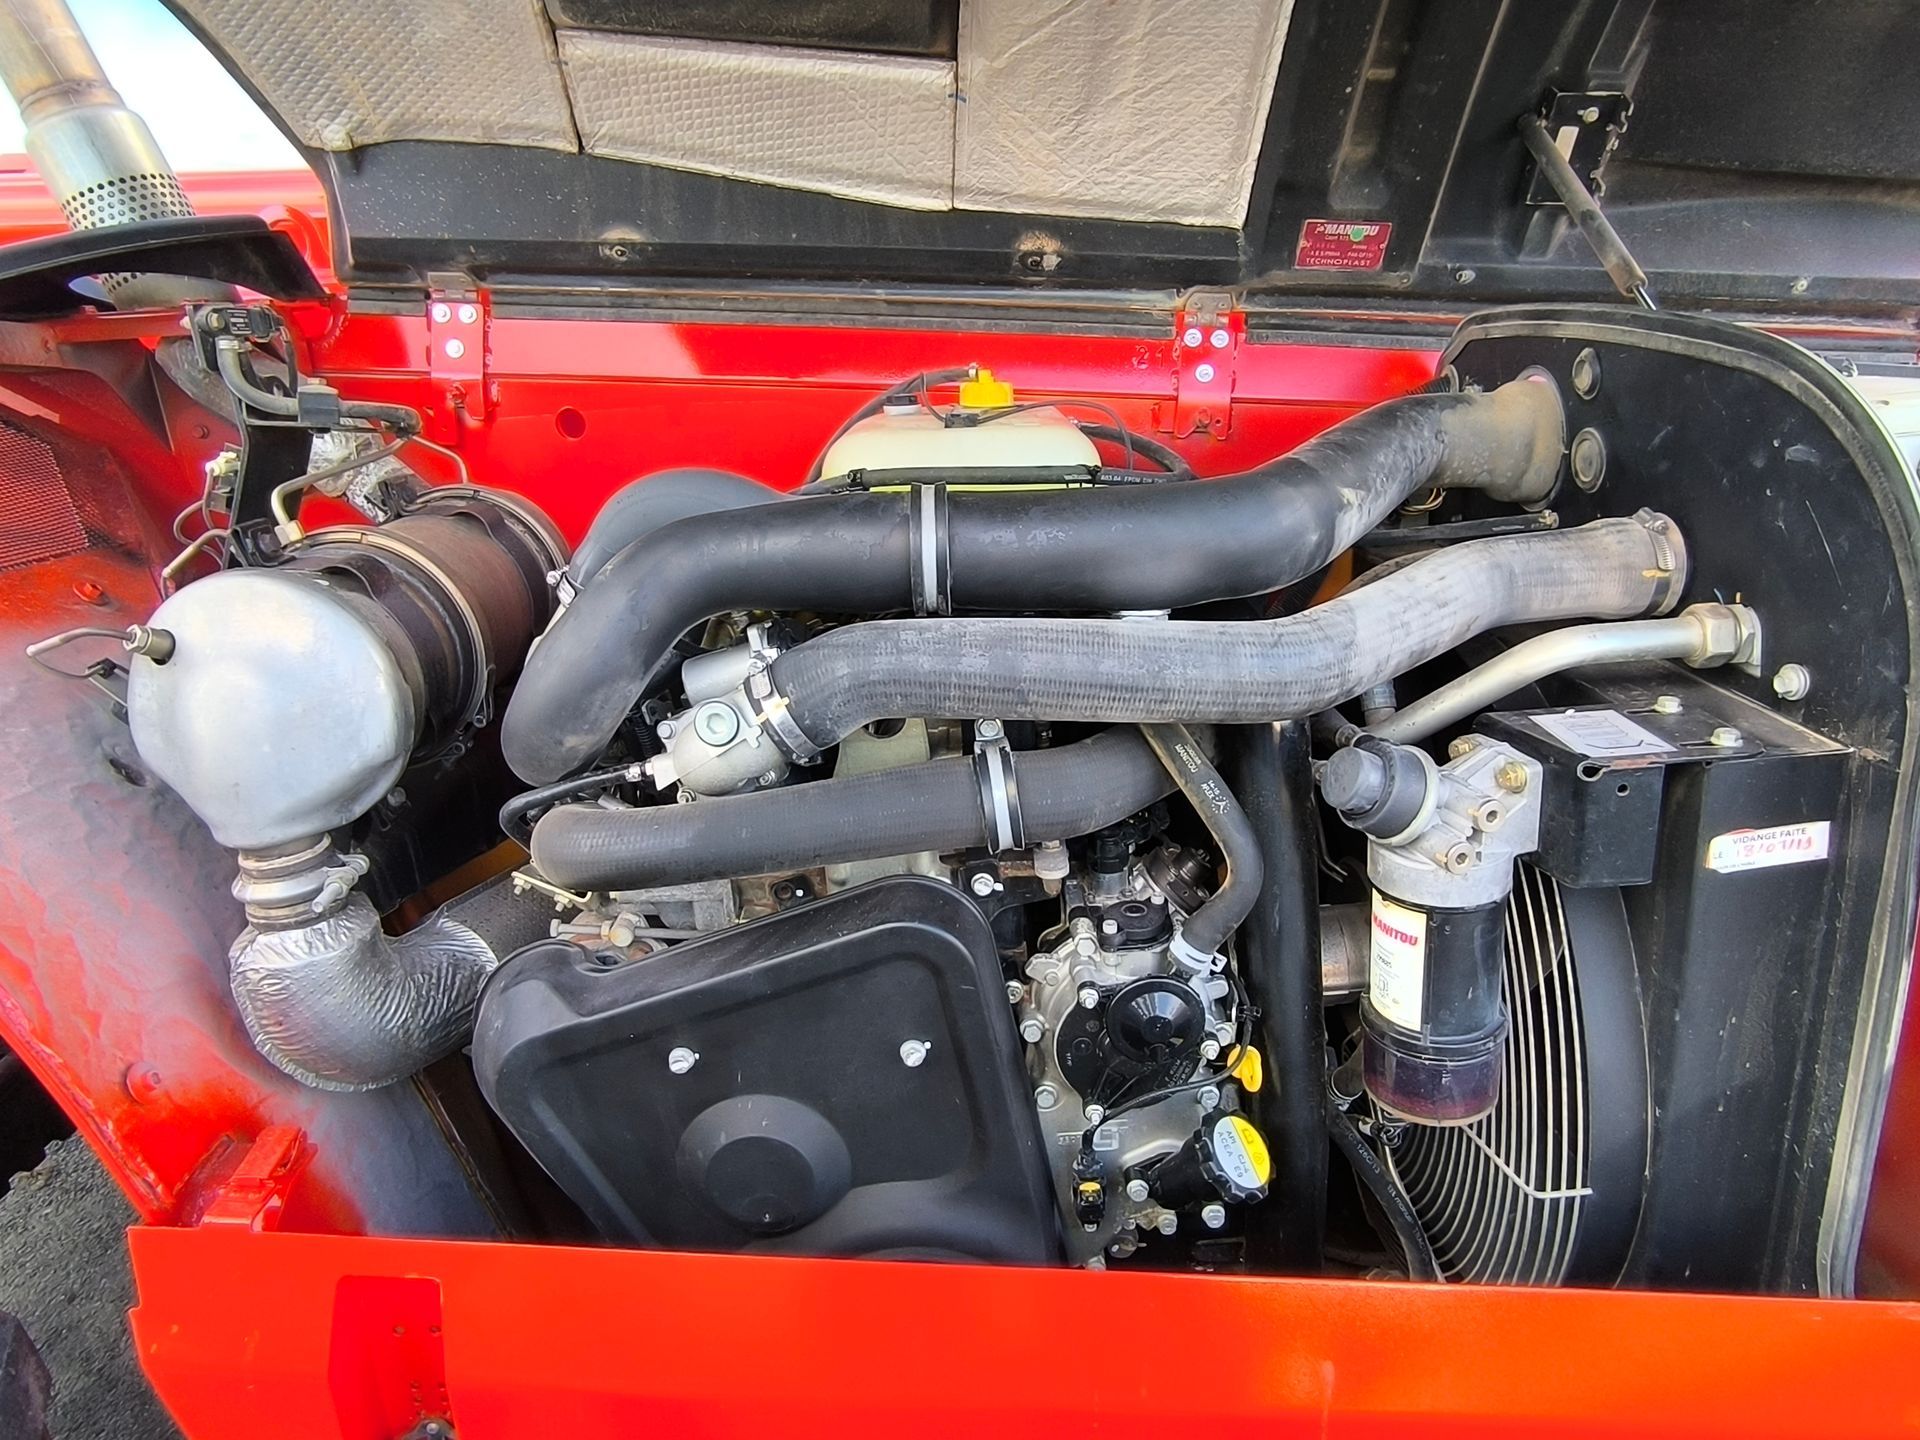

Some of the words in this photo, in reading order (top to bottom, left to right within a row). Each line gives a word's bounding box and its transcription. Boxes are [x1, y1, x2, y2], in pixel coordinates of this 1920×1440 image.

[1325, 223, 1379, 236] MANOU
[1306, 257, 1371, 267] TECHNOPLAST
[1174, 743, 1199, 774] MANITOU
[1732, 832, 1777, 845] VIDANGE
[1779, 827, 1807, 839] FAITE
[1372, 910, 1419, 946] MANITOU
[1217, 1131, 1234, 1158] ACEA
